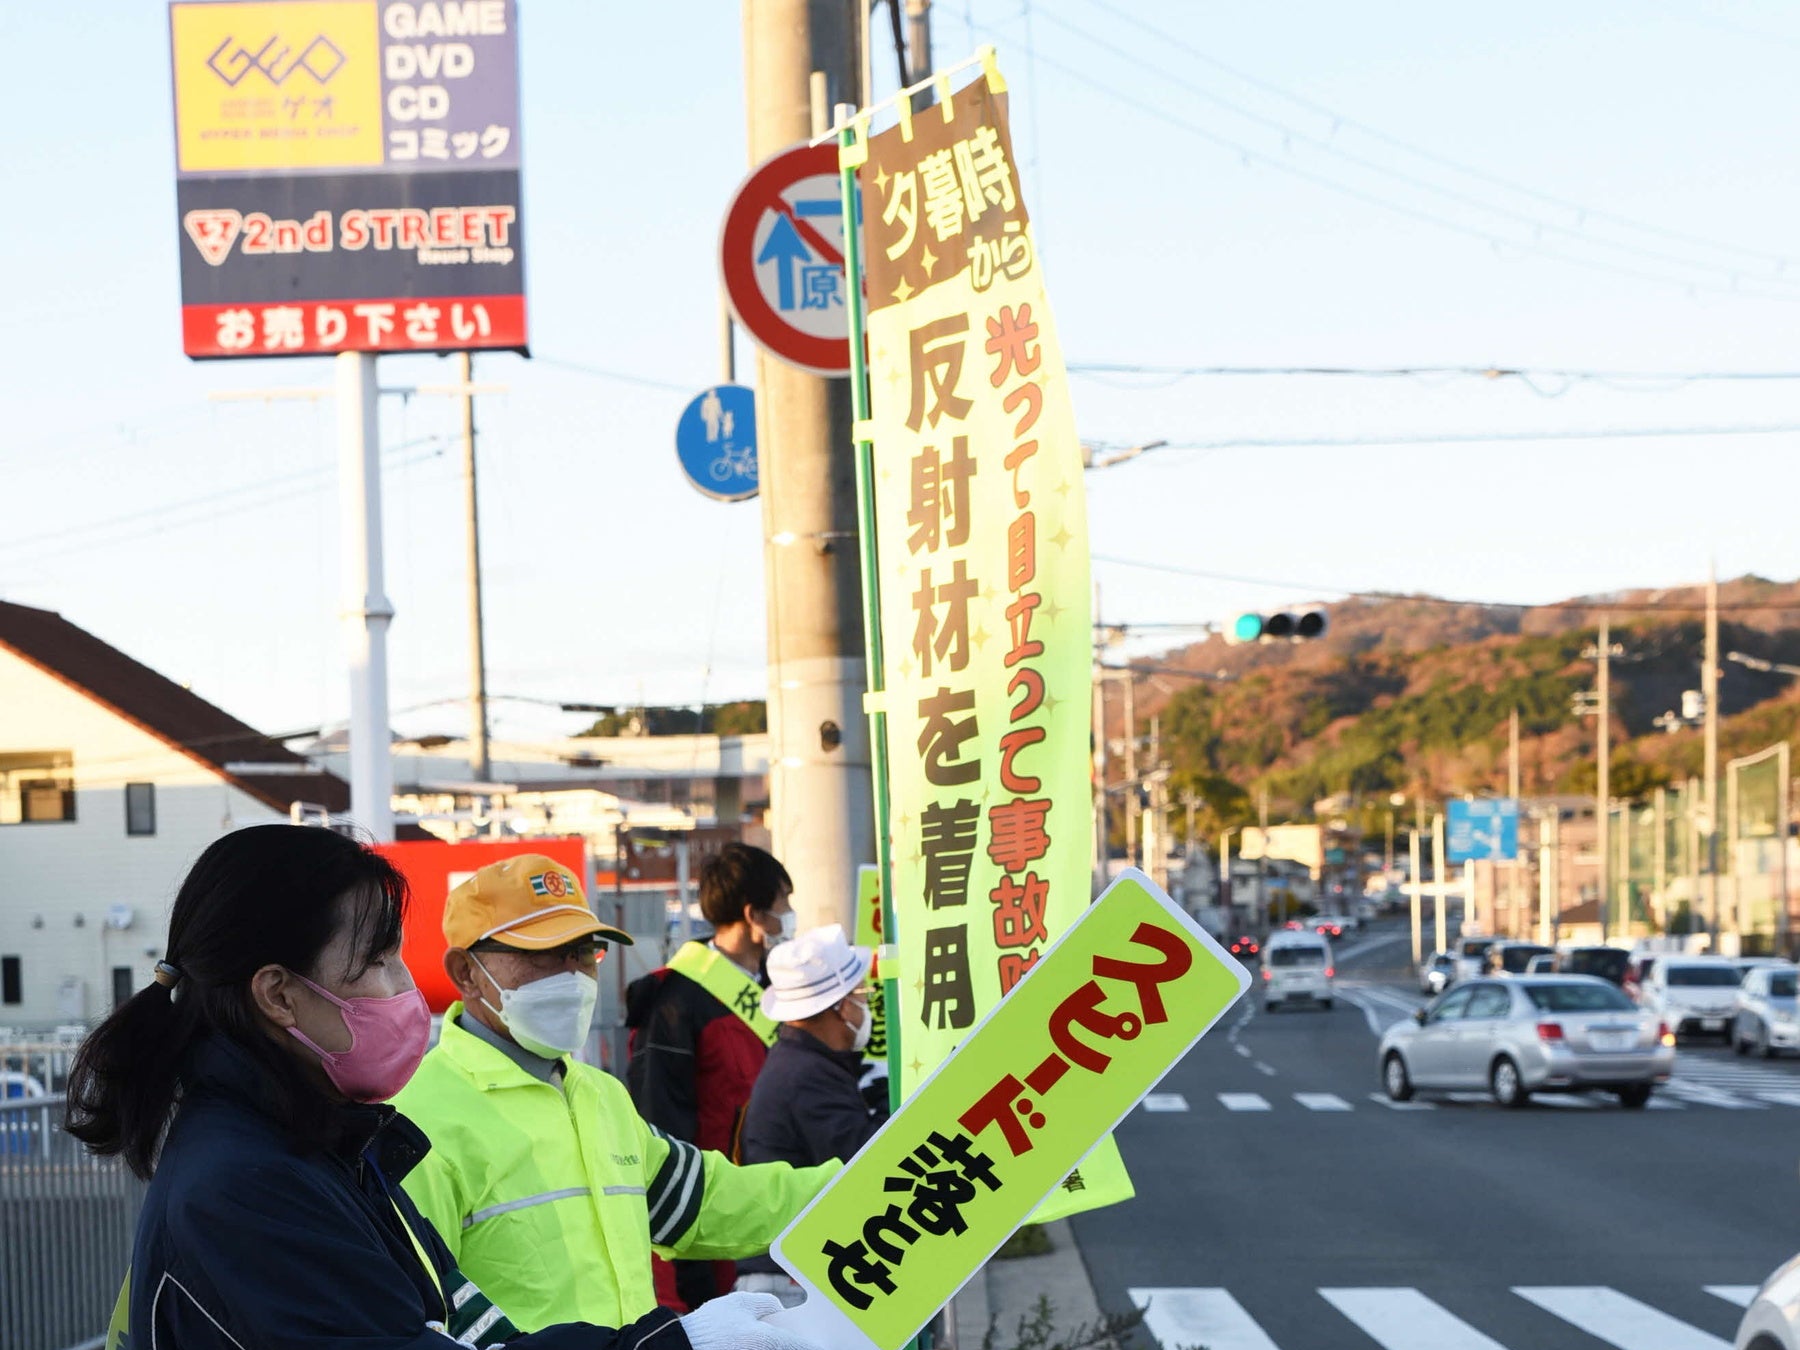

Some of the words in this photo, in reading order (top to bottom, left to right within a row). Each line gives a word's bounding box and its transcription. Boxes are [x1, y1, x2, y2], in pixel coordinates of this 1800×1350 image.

[384, 2, 506, 38] GAME
[207, 35, 347, 86] GEO
[385, 43, 474, 80] DVD
[387, 85, 450, 122] CD
[388, 124, 511, 160] コミック
[882, 127, 1016, 260] 夕暮時
[242, 211, 333, 254] 2nd
[340, 206, 515, 250] STREET
[967, 221, 1032, 291] から
[801, 263, 846, 311] 原
[216, 302, 491, 349] お売り下さい
[905, 312, 982, 1031] 反射材を着用
[821, 922, 1192, 1310] スピード落とせ
